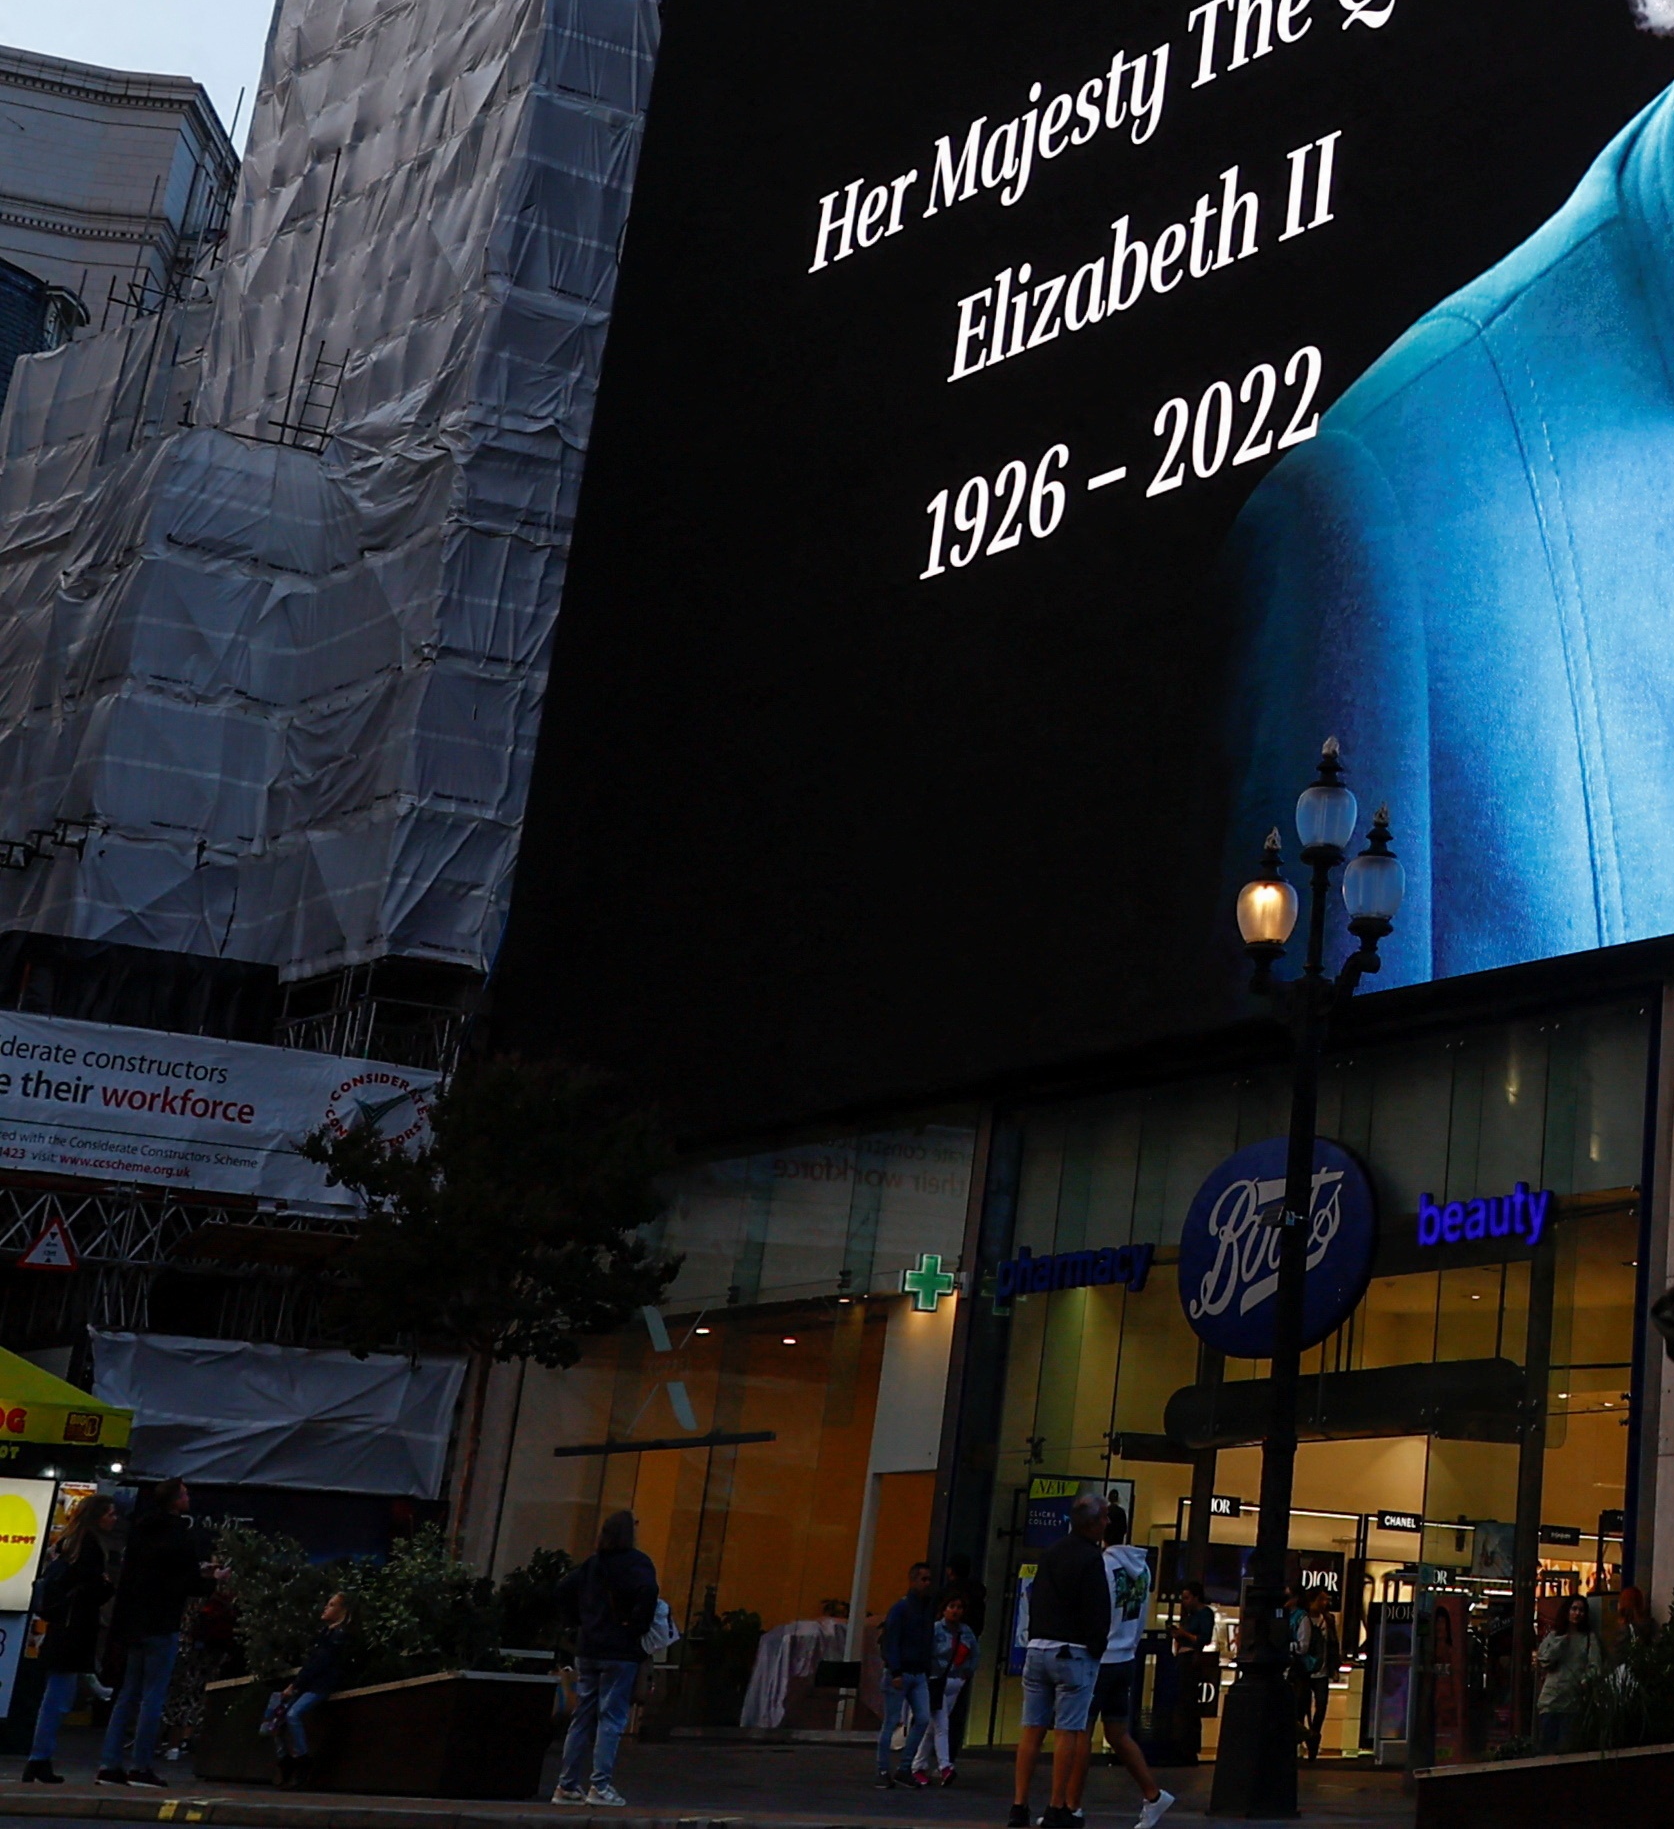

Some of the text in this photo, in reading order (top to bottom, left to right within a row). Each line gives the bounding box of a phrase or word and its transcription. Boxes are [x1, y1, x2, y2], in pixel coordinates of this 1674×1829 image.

[808, 169, 918, 274] Her
[922, 42, 1170, 219] Majesty
[946, 130, 1342, 383] Elizabeth II
[919, 443, 1069, 580] 1926
[1145, 345, 1322, 498] 2022
[0, 1035, 228, 1084] derate constructors
[21, 1070, 94, 1104] their
[102, 1085, 255, 1124] workforce
[331, 1073, 431, 1116] CONSIDERATE
[19, 1132, 45, 1144] with
[48, 1134, 67, 1147] the
[69, 1136, 138, 1156] Considerate
[140, 1144, 211, 1164] Constructors
[213, 1153, 259, 1169] Scheme
[60, 1155, 191, 1178] www.ccscheme.org.uk
[1416, 1181, 1555, 1247] beauty
[998, 1243, 1155, 1299] pharmacy
[1036, 1480, 1067, 1495] NEW
[1210, 1496, 1230, 1515] IOR
[1384, 1515, 1417, 1529] CHANEL
[1301, 1570, 1339, 1592] DIOR
